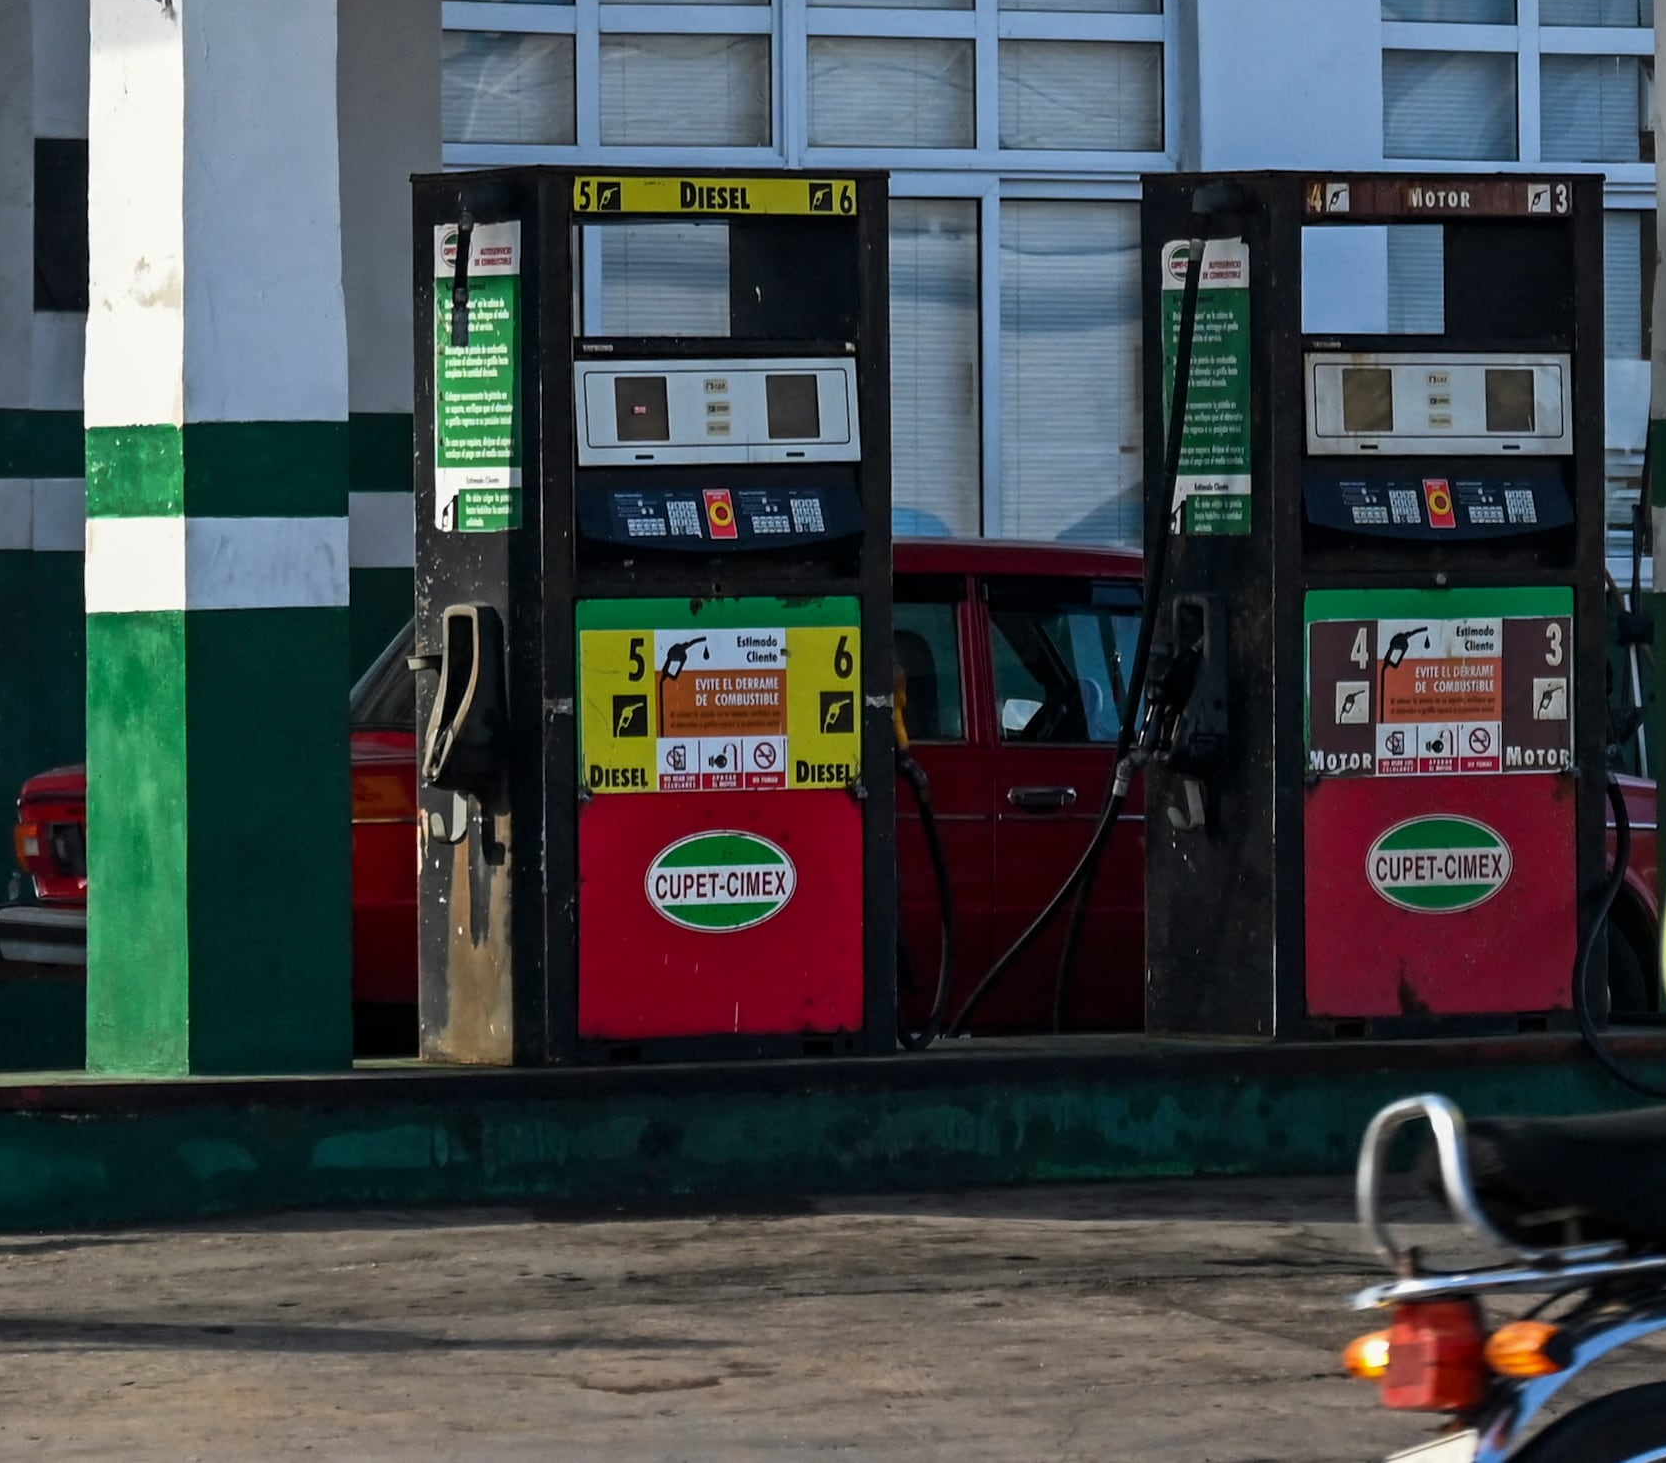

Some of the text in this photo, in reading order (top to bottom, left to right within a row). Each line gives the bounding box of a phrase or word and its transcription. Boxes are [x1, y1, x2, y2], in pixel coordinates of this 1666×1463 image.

[579, 180, 854, 214] 5 DIESEL 6
[1307, 183, 1569, 214] 4 MOTOR 3
[736, 635, 778, 648] Estimado
[1455, 624, 1495, 638] Estimado
[1350, 626, 1369, 670] 4
[1464, 639, 1495, 652] Cliente
[1545, 622, 1564, 667] 3
[628, 637, 645, 682] 5
[746, 650, 778, 663] Cliente
[833, 635, 854, 680] 6
[1415, 664, 1495, 679] EVITE EL DERRAME
[695, 676, 780, 692] EVITE EL DERRAME
[1415, 679, 1495, 694] DE COMBUSTIBLE
[695, 692, 780, 707] DE COMBUSTIBLE
[1309, 750, 1372, 772] MOTOR
[1505, 746, 1570, 768] MOTOR
[590, 764, 649, 788] DIESEL
[796, 760, 854, 784] DIESEL
[1375, 852, 1503, 881] CUPET-CIMEX
[655, 871, 787, 900] CUPET-CIMEX
